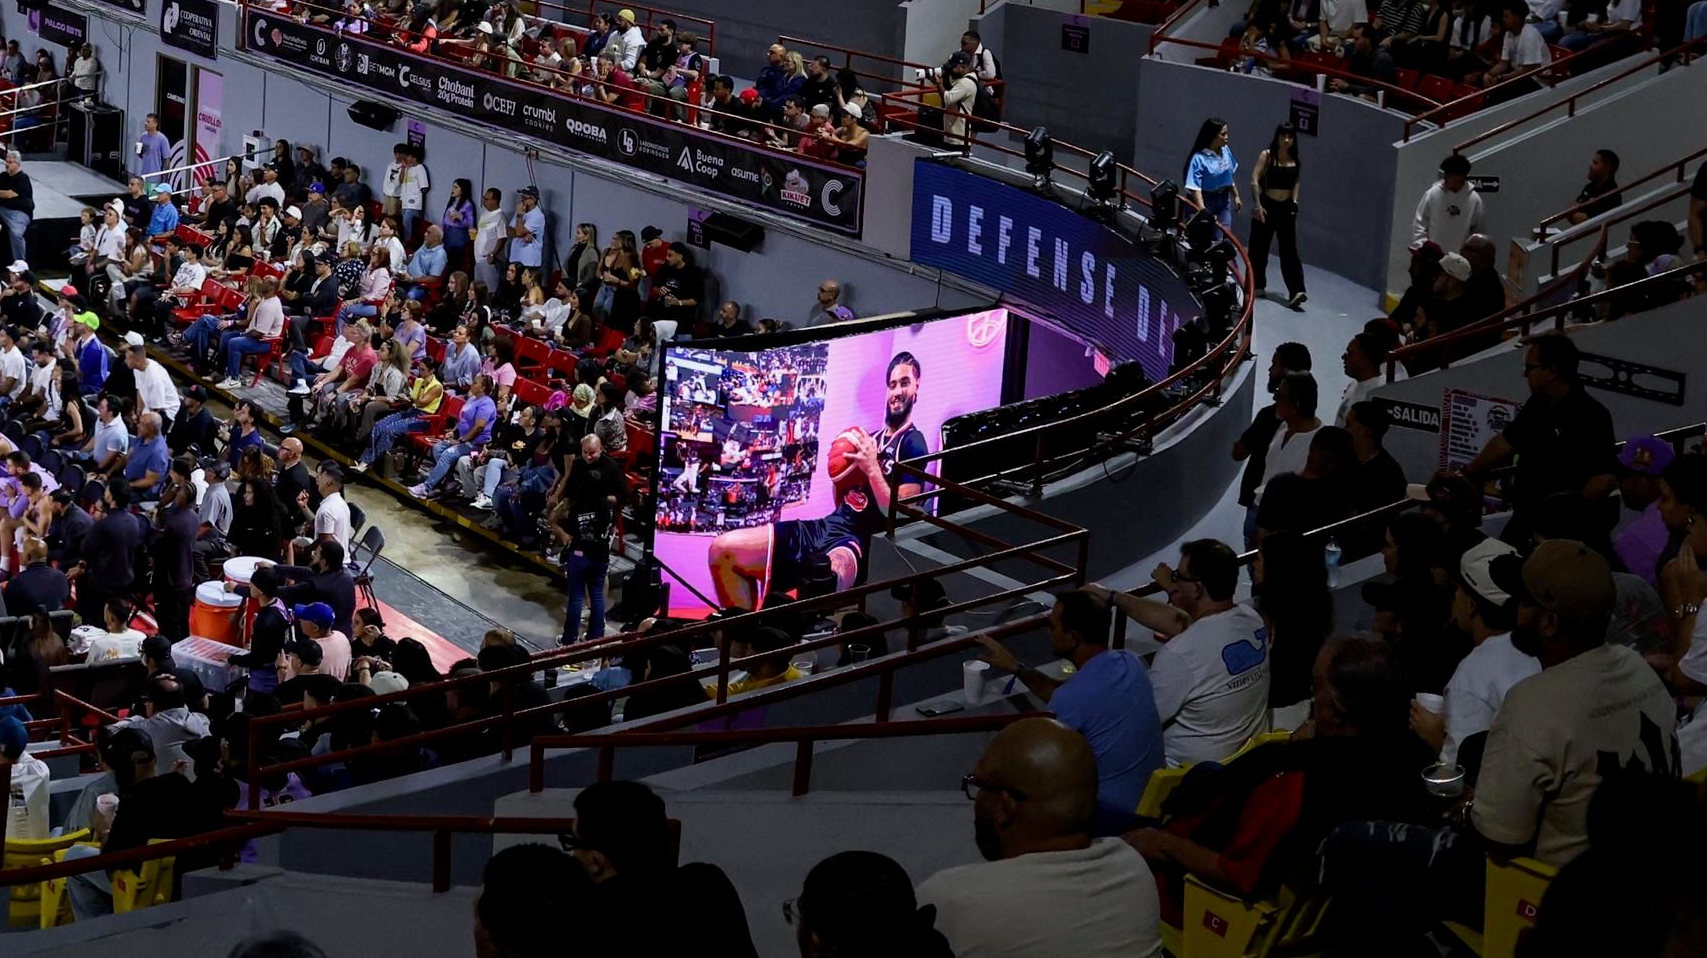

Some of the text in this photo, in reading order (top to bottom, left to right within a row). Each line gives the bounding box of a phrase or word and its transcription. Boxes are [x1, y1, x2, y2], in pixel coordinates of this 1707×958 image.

[179, 10, 213, 28] COOPERATIVA
[409, 74, 432, 89] CELSIUS
[438, 76, 475, 98] Chobani
[523, 104, 557, 124] crumbl
[525, 117, 554, 132] cookies
[566, 118, 607, 140] QDOBA
[696, 149, 724, 167] Buena
[696, 161, 719, 179] Coop
[730, 167, 759, 184] asume
[782, 191, 811, 205] KIKUET
[931, 193, 1117, 320] DEFENSE
[1393, 403, 1440, 427] SALIDA
[1525, 904, 1537, 917] D
[1211, 916, 1220, 928] C
